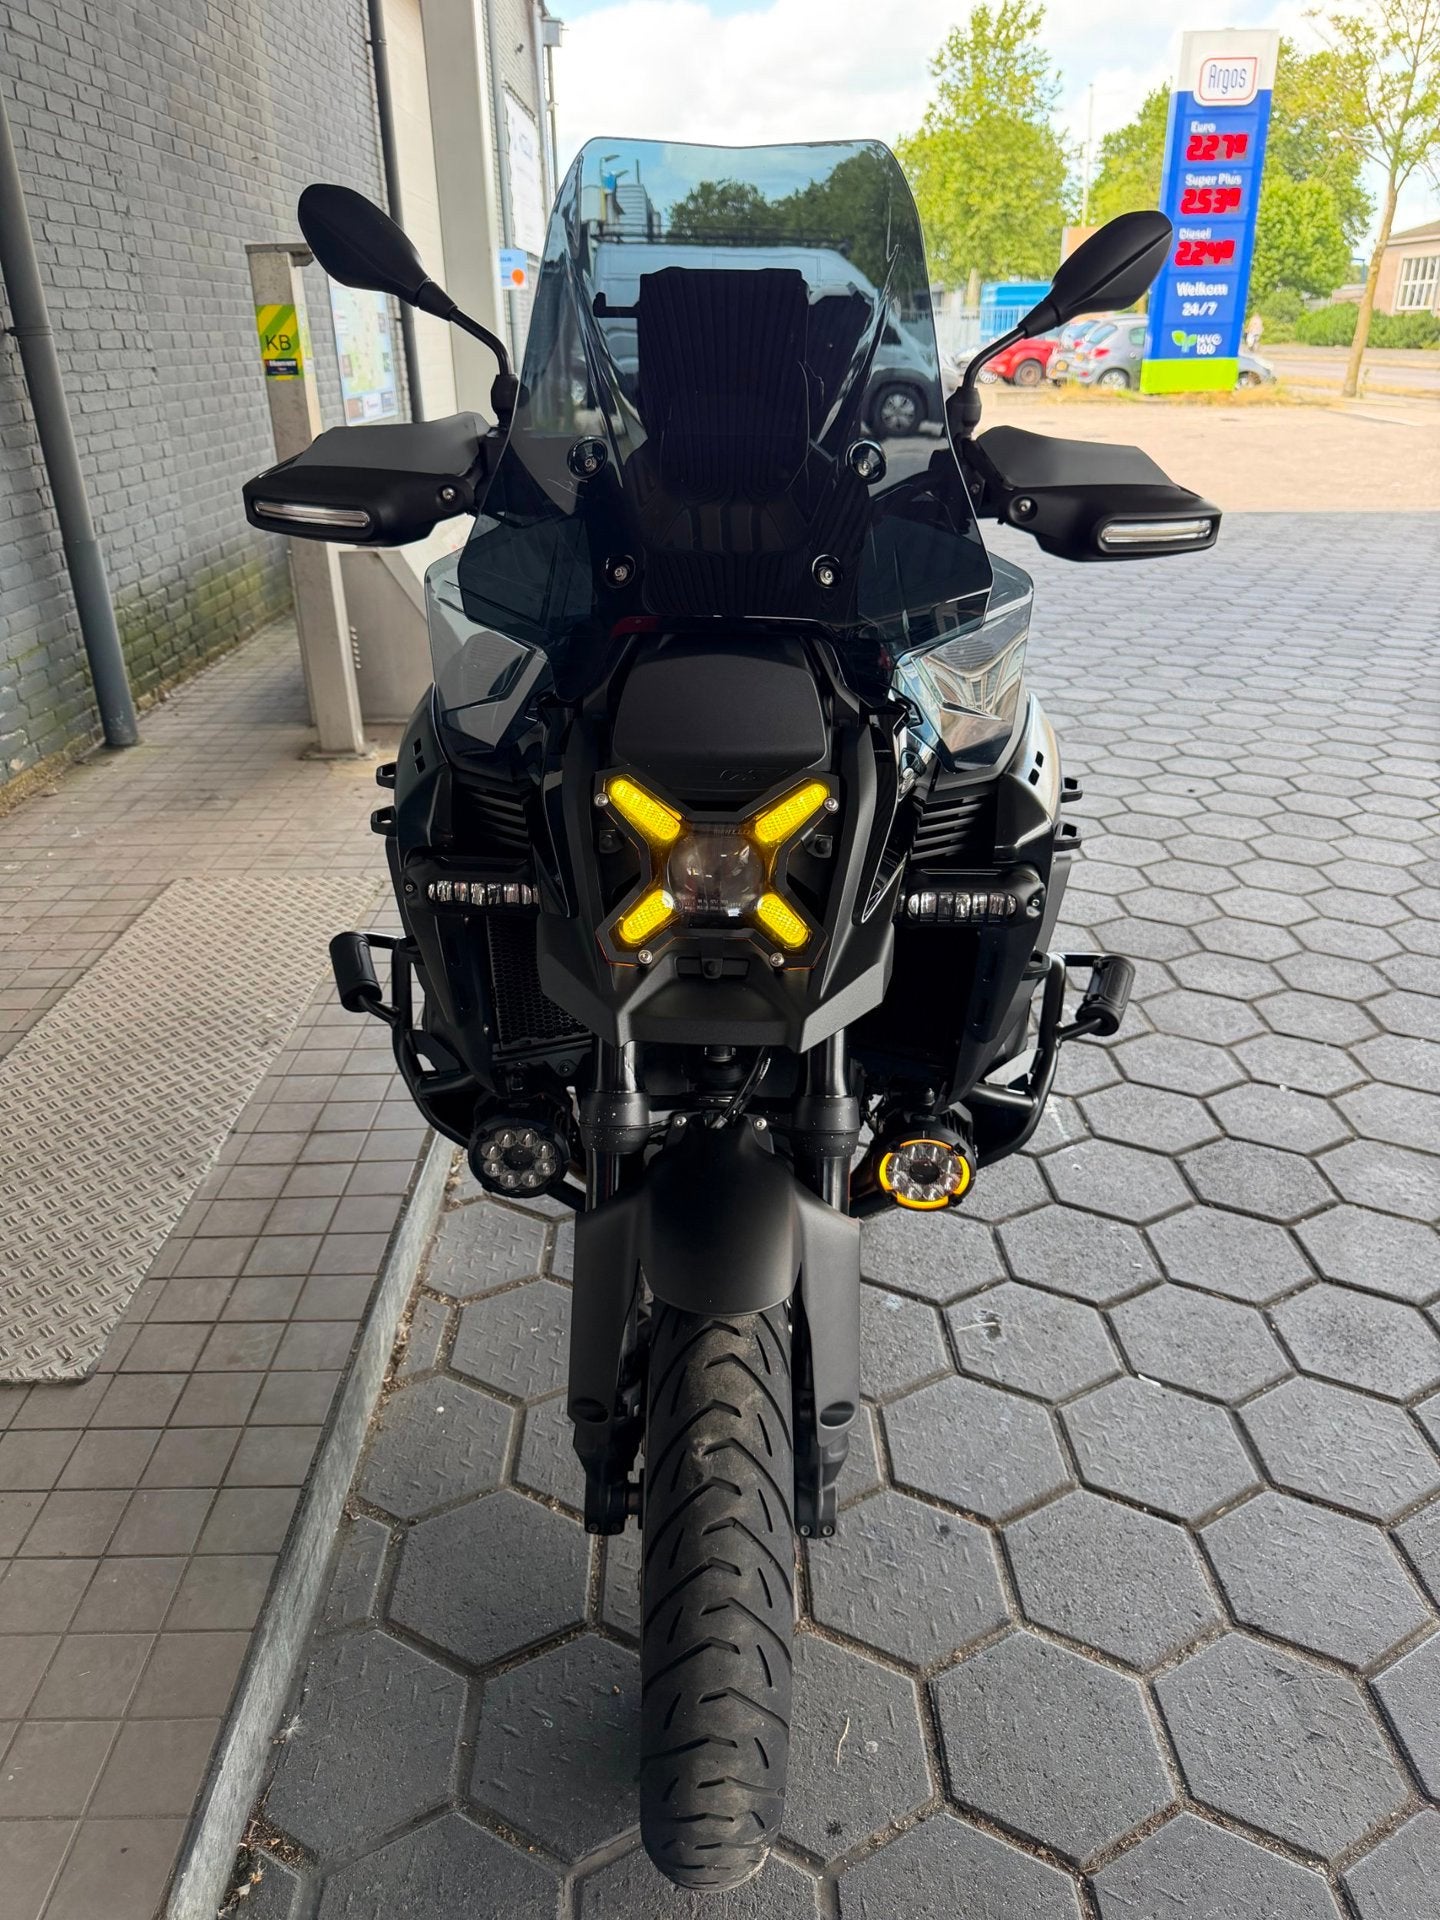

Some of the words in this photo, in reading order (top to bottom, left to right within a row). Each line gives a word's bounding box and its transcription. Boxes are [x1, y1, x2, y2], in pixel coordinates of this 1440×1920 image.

[1208, 64, 1248, 95] Argos
[1190, 121, 1217, 133] Euro
[1185, 174, 1217, 188] Super
[1218, 172, 1243, 185] Plus
[1179, 228, 1212, 240] Diesel
[1176, 281, 1229, 297] Welkom
[1181, 302, 1218, 317] 24/7
[265, 334, 292, 351] KB
[1196, 343, 1216, 355] 100
